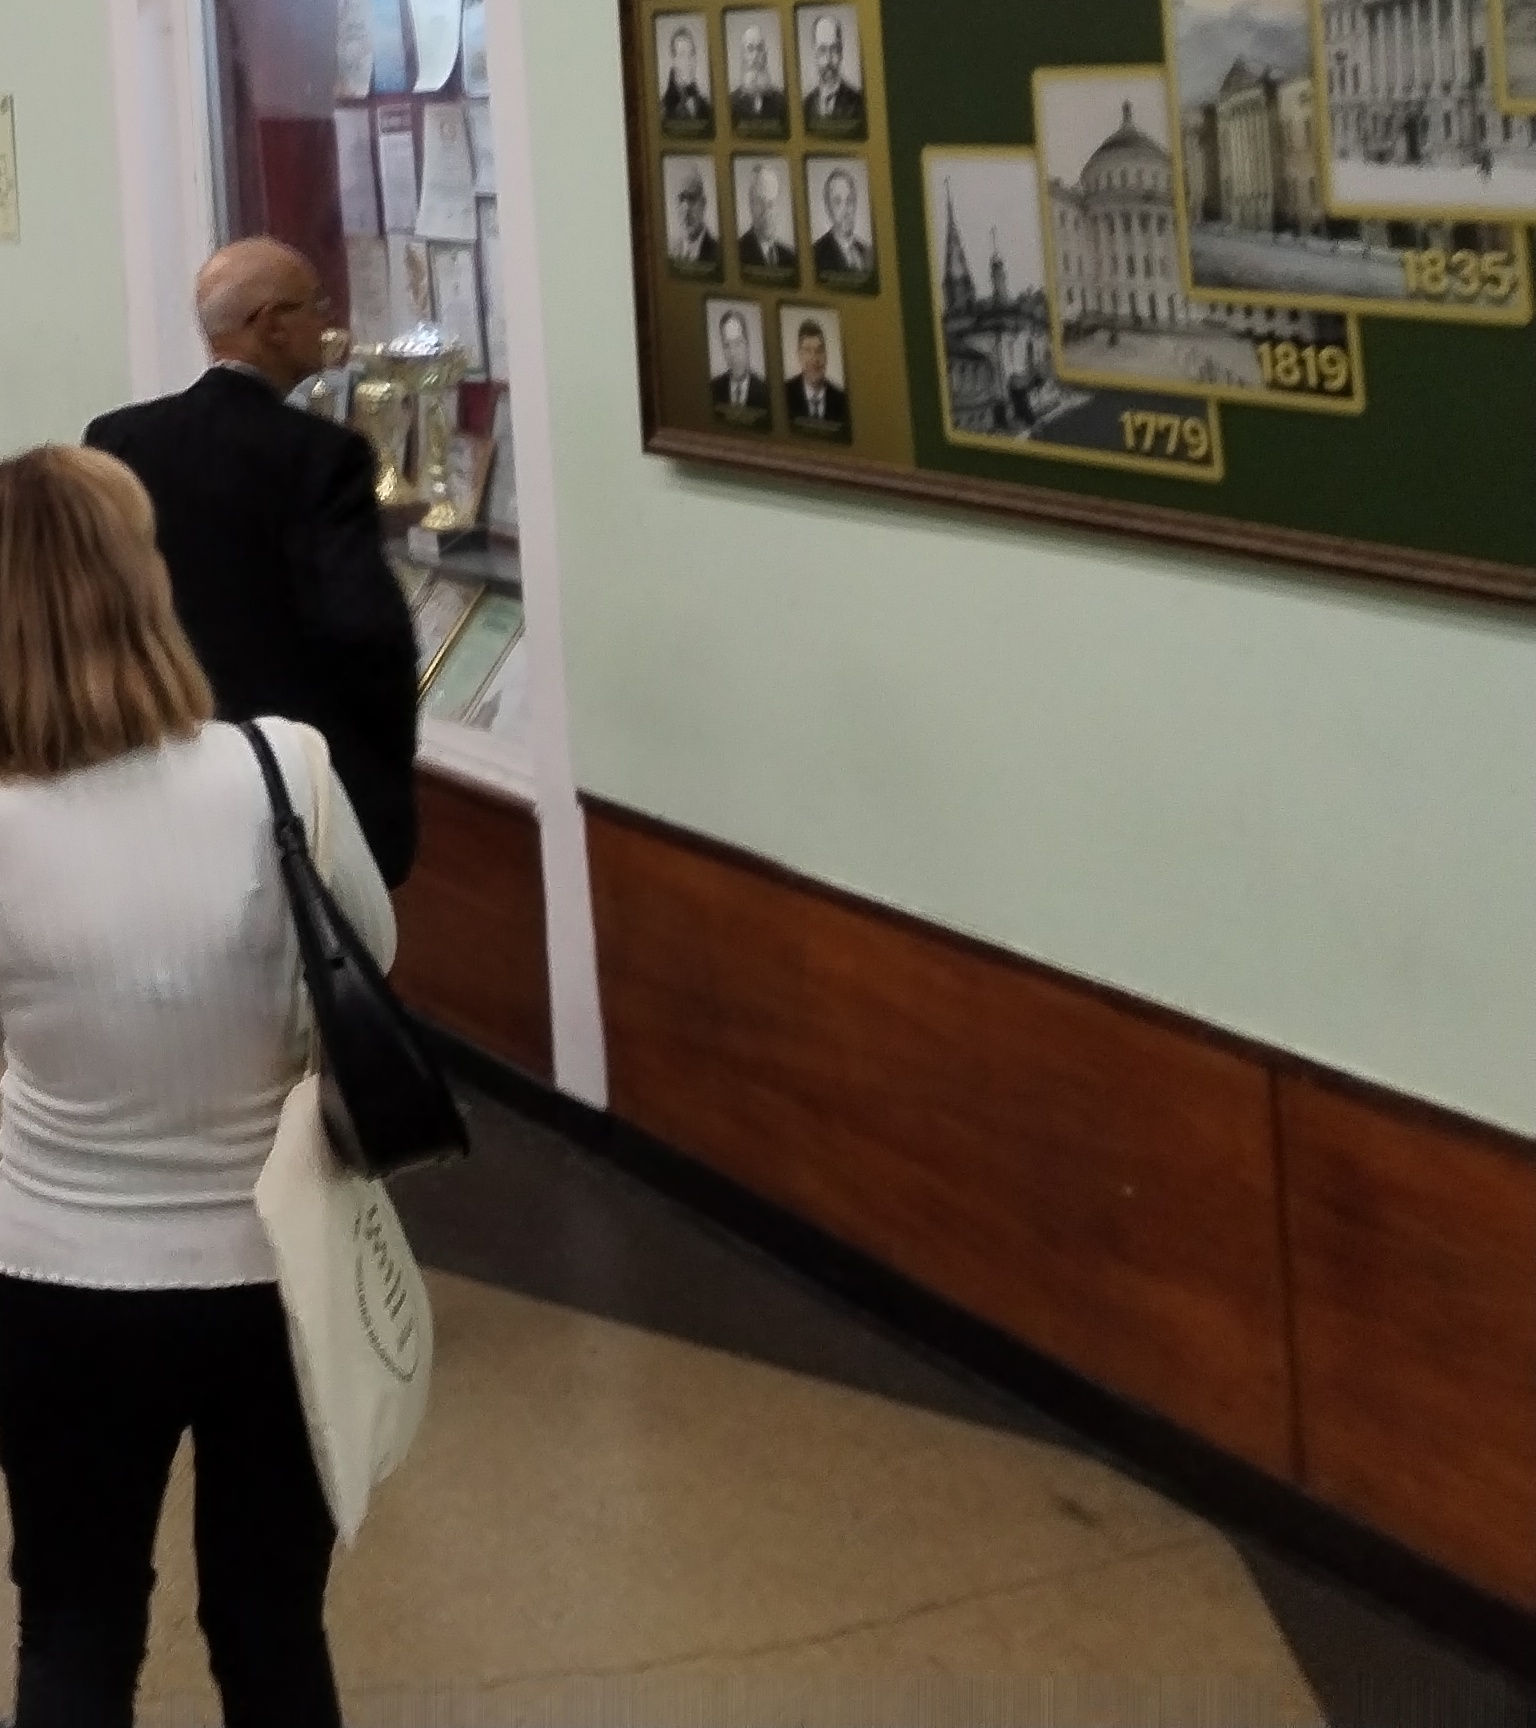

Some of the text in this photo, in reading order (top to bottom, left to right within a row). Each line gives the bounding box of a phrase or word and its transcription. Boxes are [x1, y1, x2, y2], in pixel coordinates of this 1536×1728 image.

[1403, 247, 1511, 296] 1835
[1257, 342, 1349, 392] 1819
[1120, 410, 1209, 460] 1779
